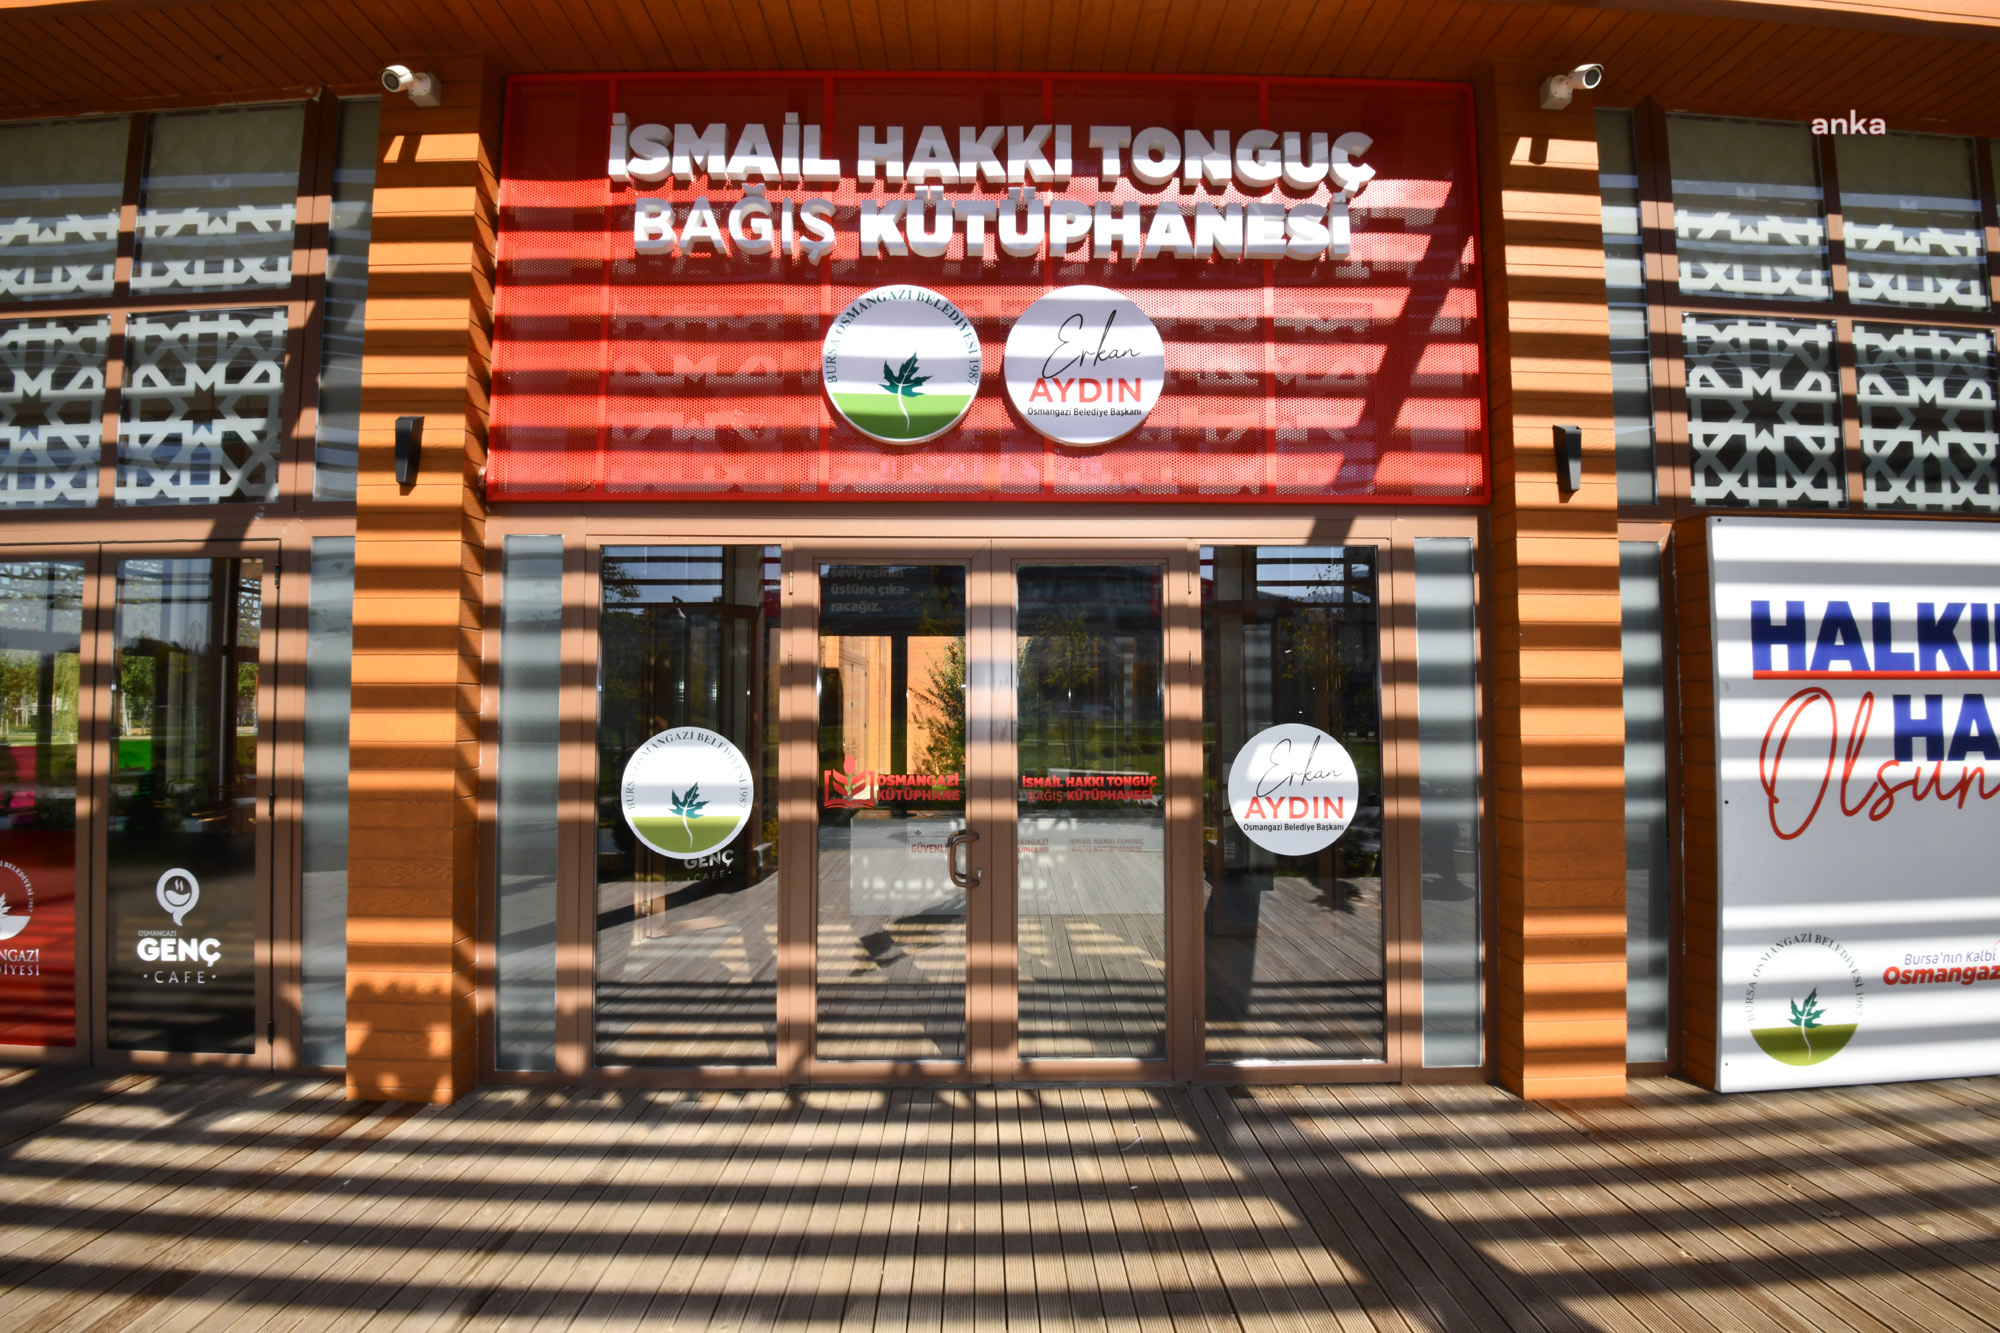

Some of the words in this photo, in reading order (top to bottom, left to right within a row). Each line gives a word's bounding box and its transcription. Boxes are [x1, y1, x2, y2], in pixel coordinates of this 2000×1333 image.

[608, 112, 841, 181] İSMAİL
[858, 124, 1072, 184] HAKKI
[1089, 126, 1376, 197] TONGUÇ
[634, 183, 837, 266] BAĞIŞ
[860, 185, 1350, 260] KÜTÜPHANESİ
[826, 339, 840, 384] BURSA
[835, 288, 912, 335] OSMANGAZİ
[967, 359, 979, 386] 1987
[1042, 309, 1141, 379] Erkan
[1028, 378, 1141, 403] AYDIN
[1027, 407, 1071, 417] Osmangazi
[1074, 407, 1108, 417] Belediye
[1110, 407, 1141, 417] Başkanı
[831, 584, 876, 595] üstüne
[1256, 735, 1343, 798] Erkan
[1759, 687, 2000, 840] Olsun
[877, 772, 959, 787] OSMANGAZİ
[1022, 775, 1063, 788] İSMAİL
[1066, 776, 1104, 788] HAKKI
[1107, 776, 1157, 790] TONGUÇ
[738, 786, 748, 809] 1987
[877, 787, 960, 801] KÜTÜPHANE
[1027, 787, 1063, 803] BAĞIŞ
[1067, 787, 1153, 801] KÜTÜPHANESİ
[1244, 796, 1344, 819] AYDIN
[1243, 823, 1282, 832] Osmangazi
[1284, 823, 1315, 832] Belediye
[1316, 823, 1344, 832] Başkanı
[137, 937, 221, 967] GENÇ
[1904, 952, 1962, 965] Bursa'nın
[1966, 949, 1996, 962] Kalbi
[0, 963, 40, 976] İYESİ
[154, 971, 206, 984] CAFE
